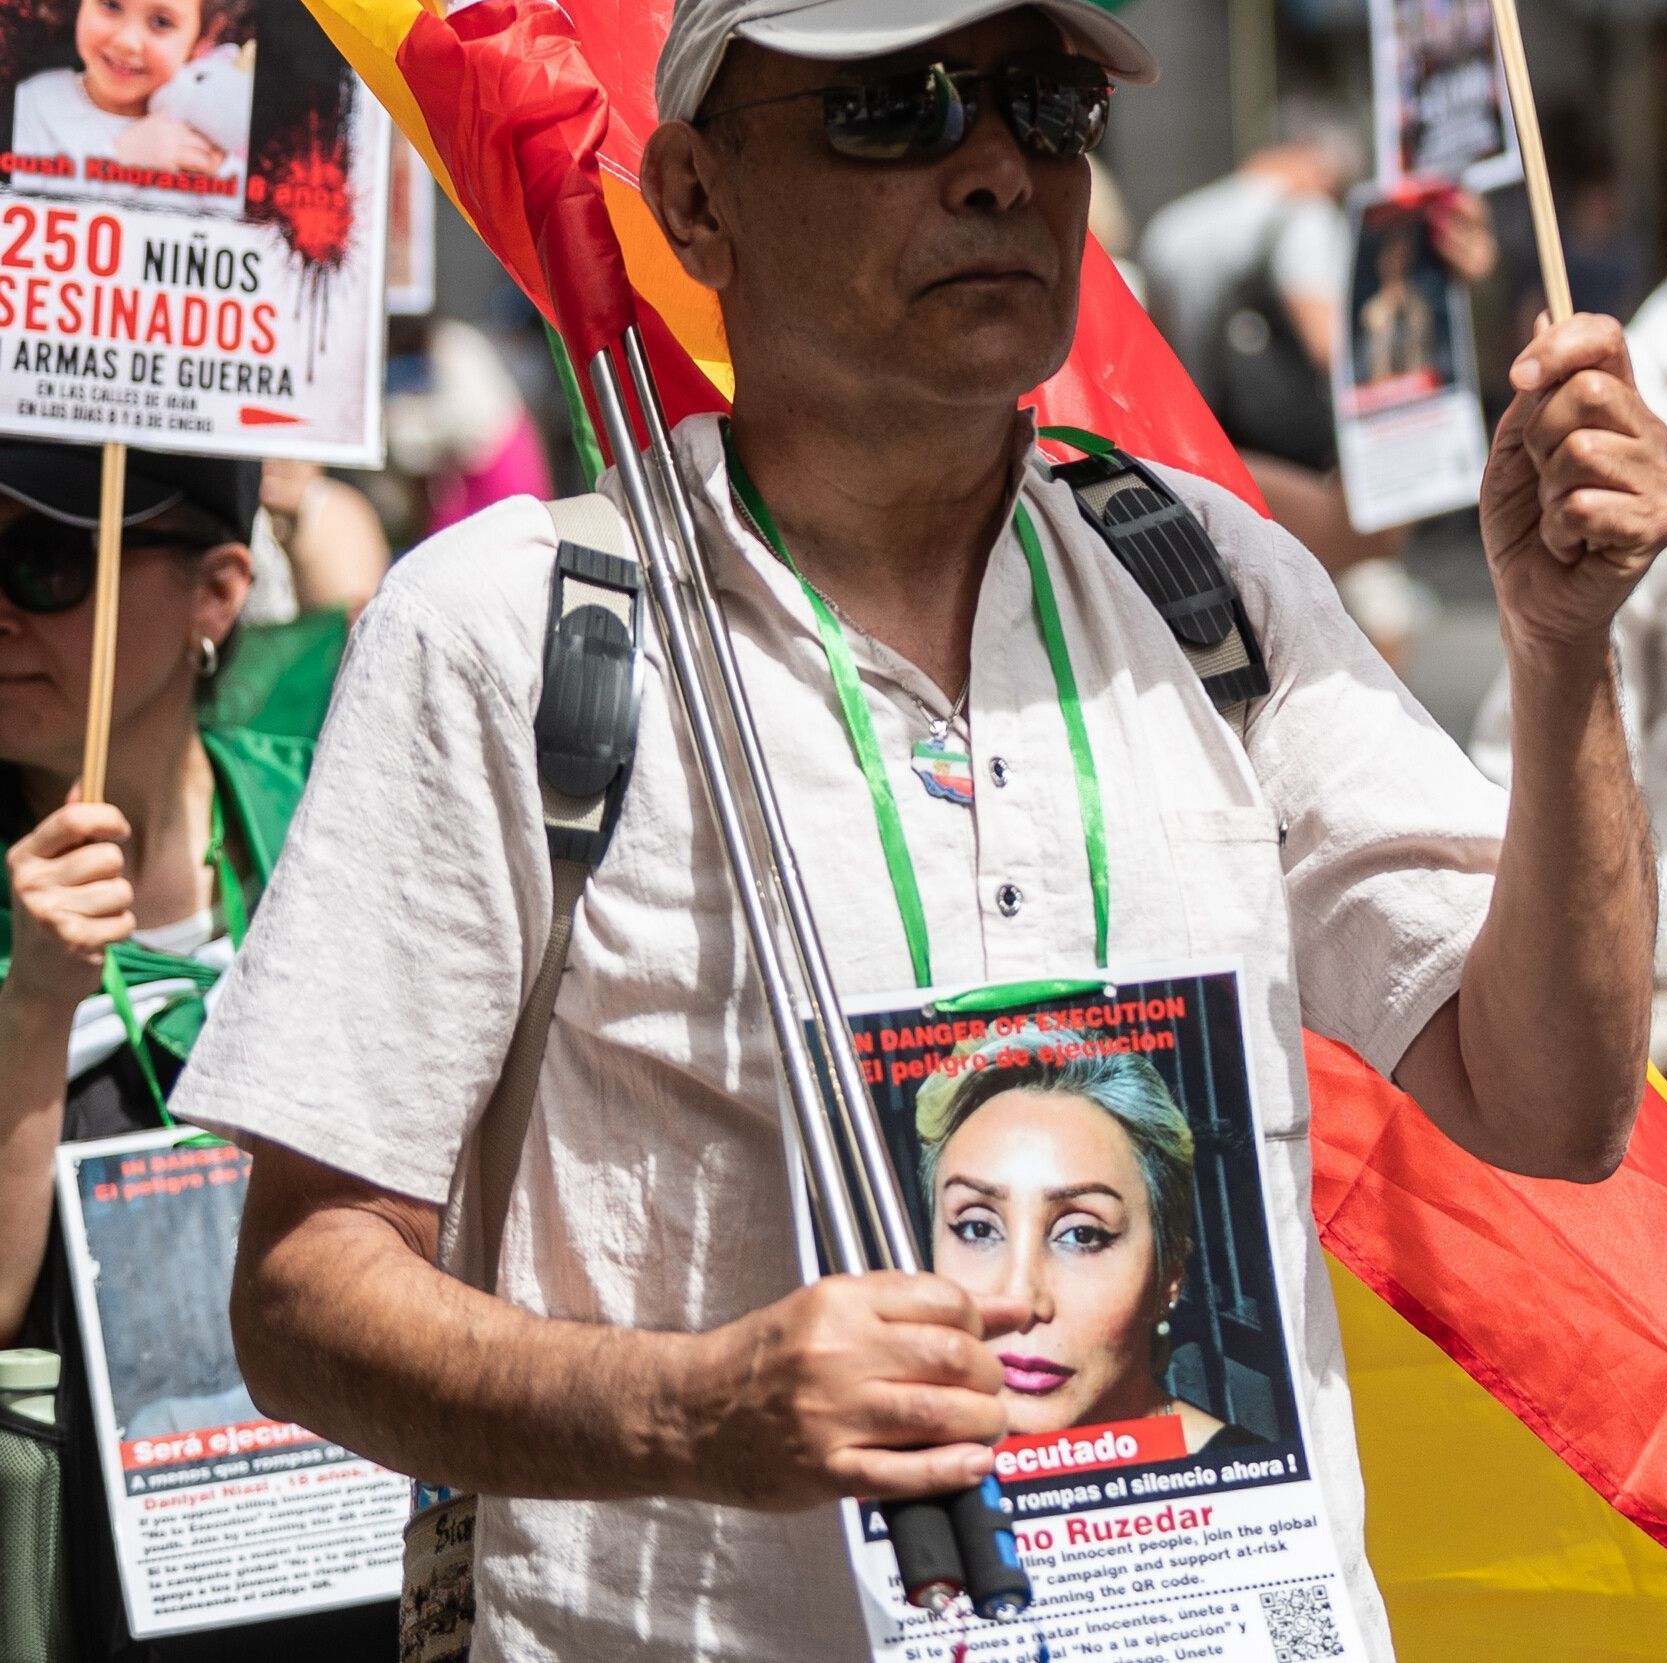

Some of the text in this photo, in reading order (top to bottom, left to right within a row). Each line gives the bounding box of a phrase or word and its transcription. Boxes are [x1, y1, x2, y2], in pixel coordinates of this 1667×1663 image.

[1, 206, 262, 293] 250 NIÑOS
[0, 274, 279, 356] SESINADOS
[13, 339, 294, 398] ARMAS DE GUERRA
[854, 996, 1186, 1054] N DANGER OF EXECUTION
[891, 1051, 988, 1087] peligro
[996, 1045, 1030, 1068] de
[1037, 1026, 1175, 1067] ejecución
[132, 1433, 203, 1464] Será
[994, 1430, 1139, 1476] ecutado
[131, 1474, 147, 1491] A
[1017, 1483, 1102, 1513] rompas
[1104, 1476, 1129, 1499] el
[1131, 1465, 1217, 1494] silencio
[1221, 1457, 1285, 1483] ahora
[1286, 1453, 1298, 1473] !
[868, 1511, 888, 1534] A
[1061, 1543, 1139, 1563] innocent
[1139, 1534, 1198, 1554] people,
[1202, 1528, 1233, 1546] join
[1237, 1523, 1263, 1538] the
[1269, 1515, 1318, 1536] global
[1065, 1503, 1213, 1545] Ruzedar
[1047, 1540, 1288, 1585] campaign and support at-risk
[1030, 1573, 1205, 1609] canning the QR code.
[905, 1647, 921, 1662] Si
[927, 1645, 943, 1658] te
[1016, 1635, 1026, 1645] a
[1086, 1613, 1174, 1634] inocentes,
[1231, 1603, 1240, 1613] a
[1109, 1641, 1119, 1651] a
[1124, 1636, 1139, 1648] la
[1238, 1620, 1247, 1634] y
